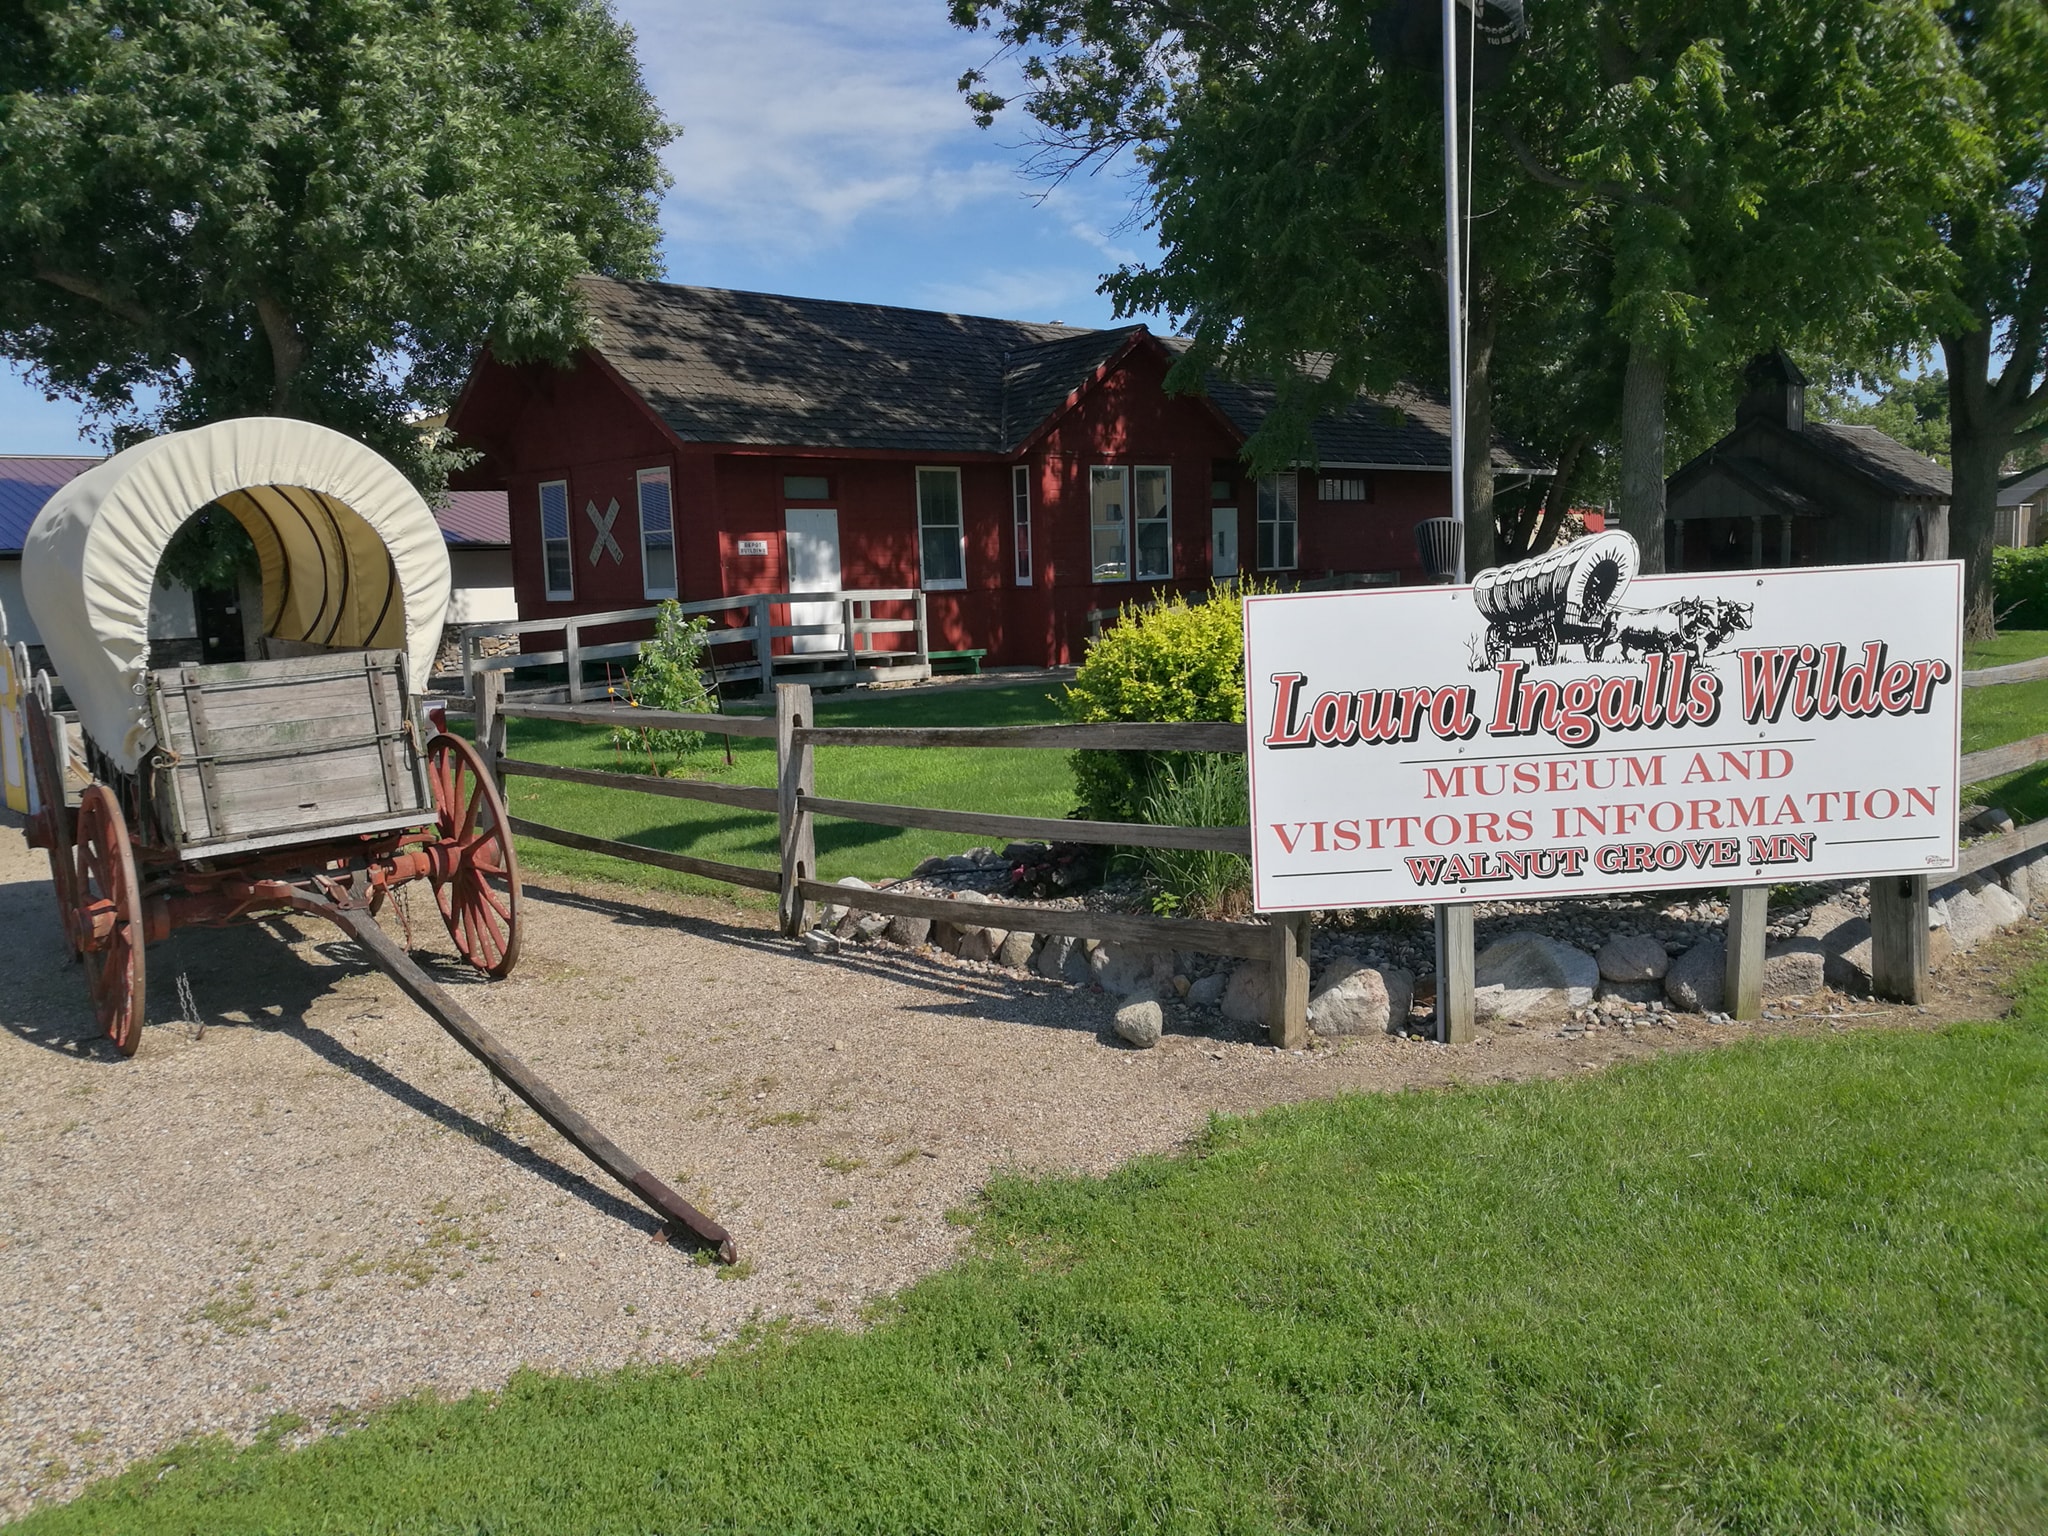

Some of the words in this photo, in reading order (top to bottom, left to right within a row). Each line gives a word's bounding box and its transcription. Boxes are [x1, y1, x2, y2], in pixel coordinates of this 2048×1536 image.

[1264, 672, 1481, 749] Laura
[1487, 651, 1723, 749] Ingalls
[1737, 640, 1952, 725] Wilder
[1423, 754, 1668, 799] MUSEUM
[1681, 748, 1795, 784] AND
[1270, 809, 1535, 854] VISITORS
[1551, 786, 1942, 839] INFORMATION
[1404, 846, 1588, 886] WALNUT
[1594, 837, 1741, 875] GROVE
[1748, 832, 1818, 866] MN
